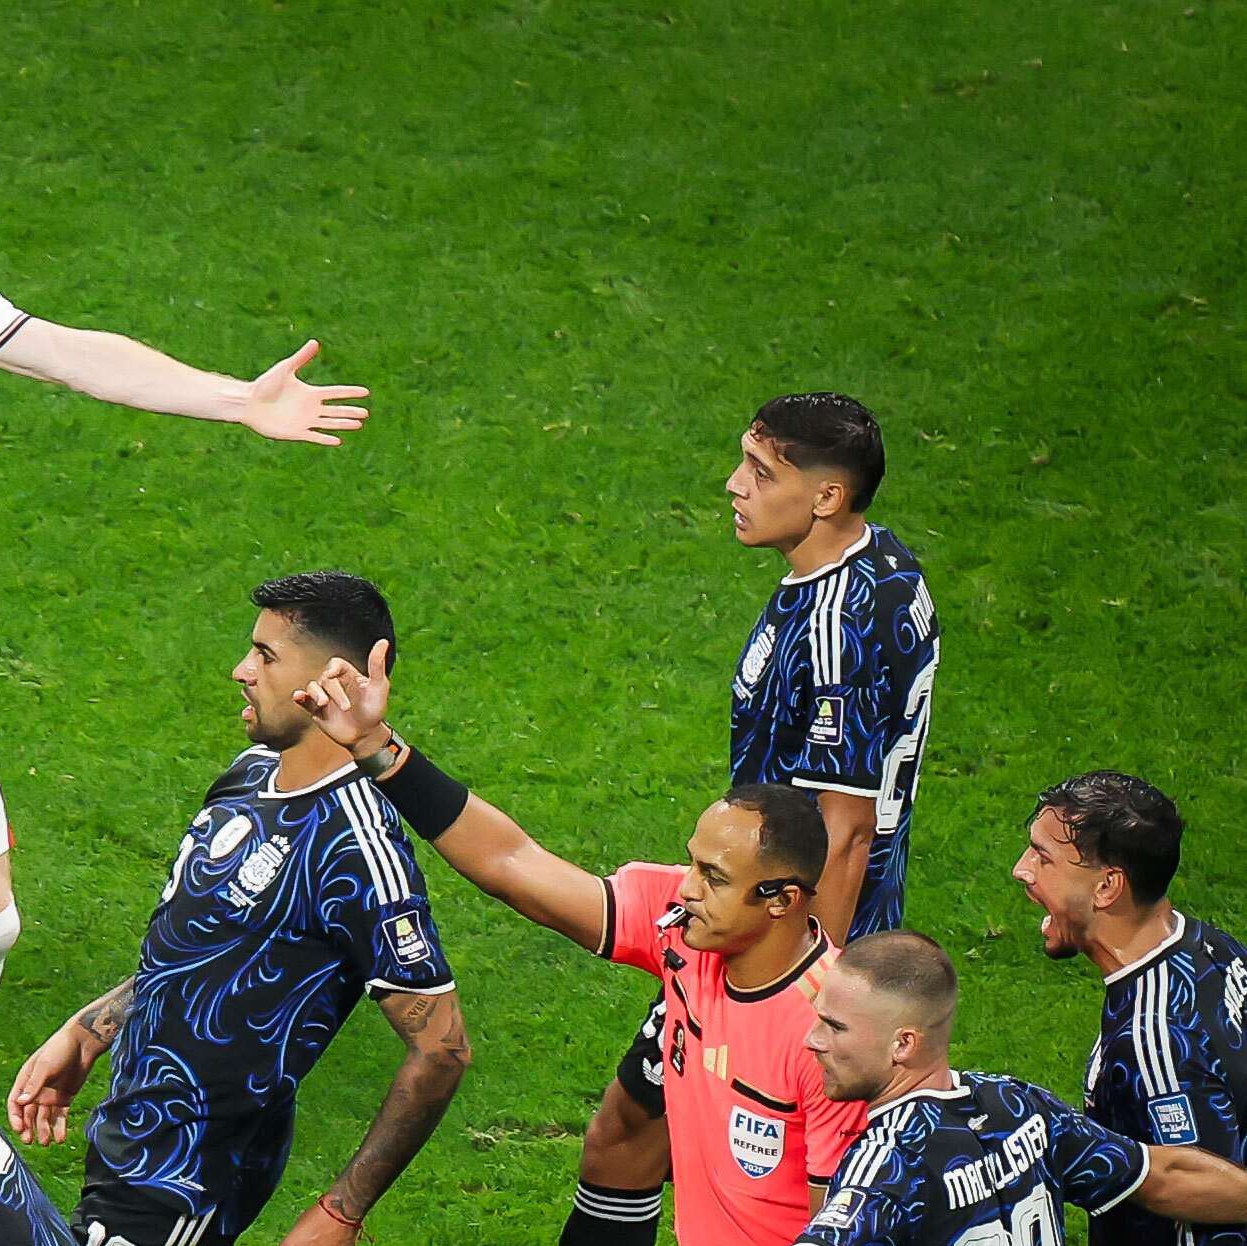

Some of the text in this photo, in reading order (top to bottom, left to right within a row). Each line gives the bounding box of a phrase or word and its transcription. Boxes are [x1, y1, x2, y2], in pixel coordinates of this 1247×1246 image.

[875, 635, 940, 834] 2
[735, 1113, 779, 1139] FIFA
[734, 1138, 778, 1156] REFEREE
